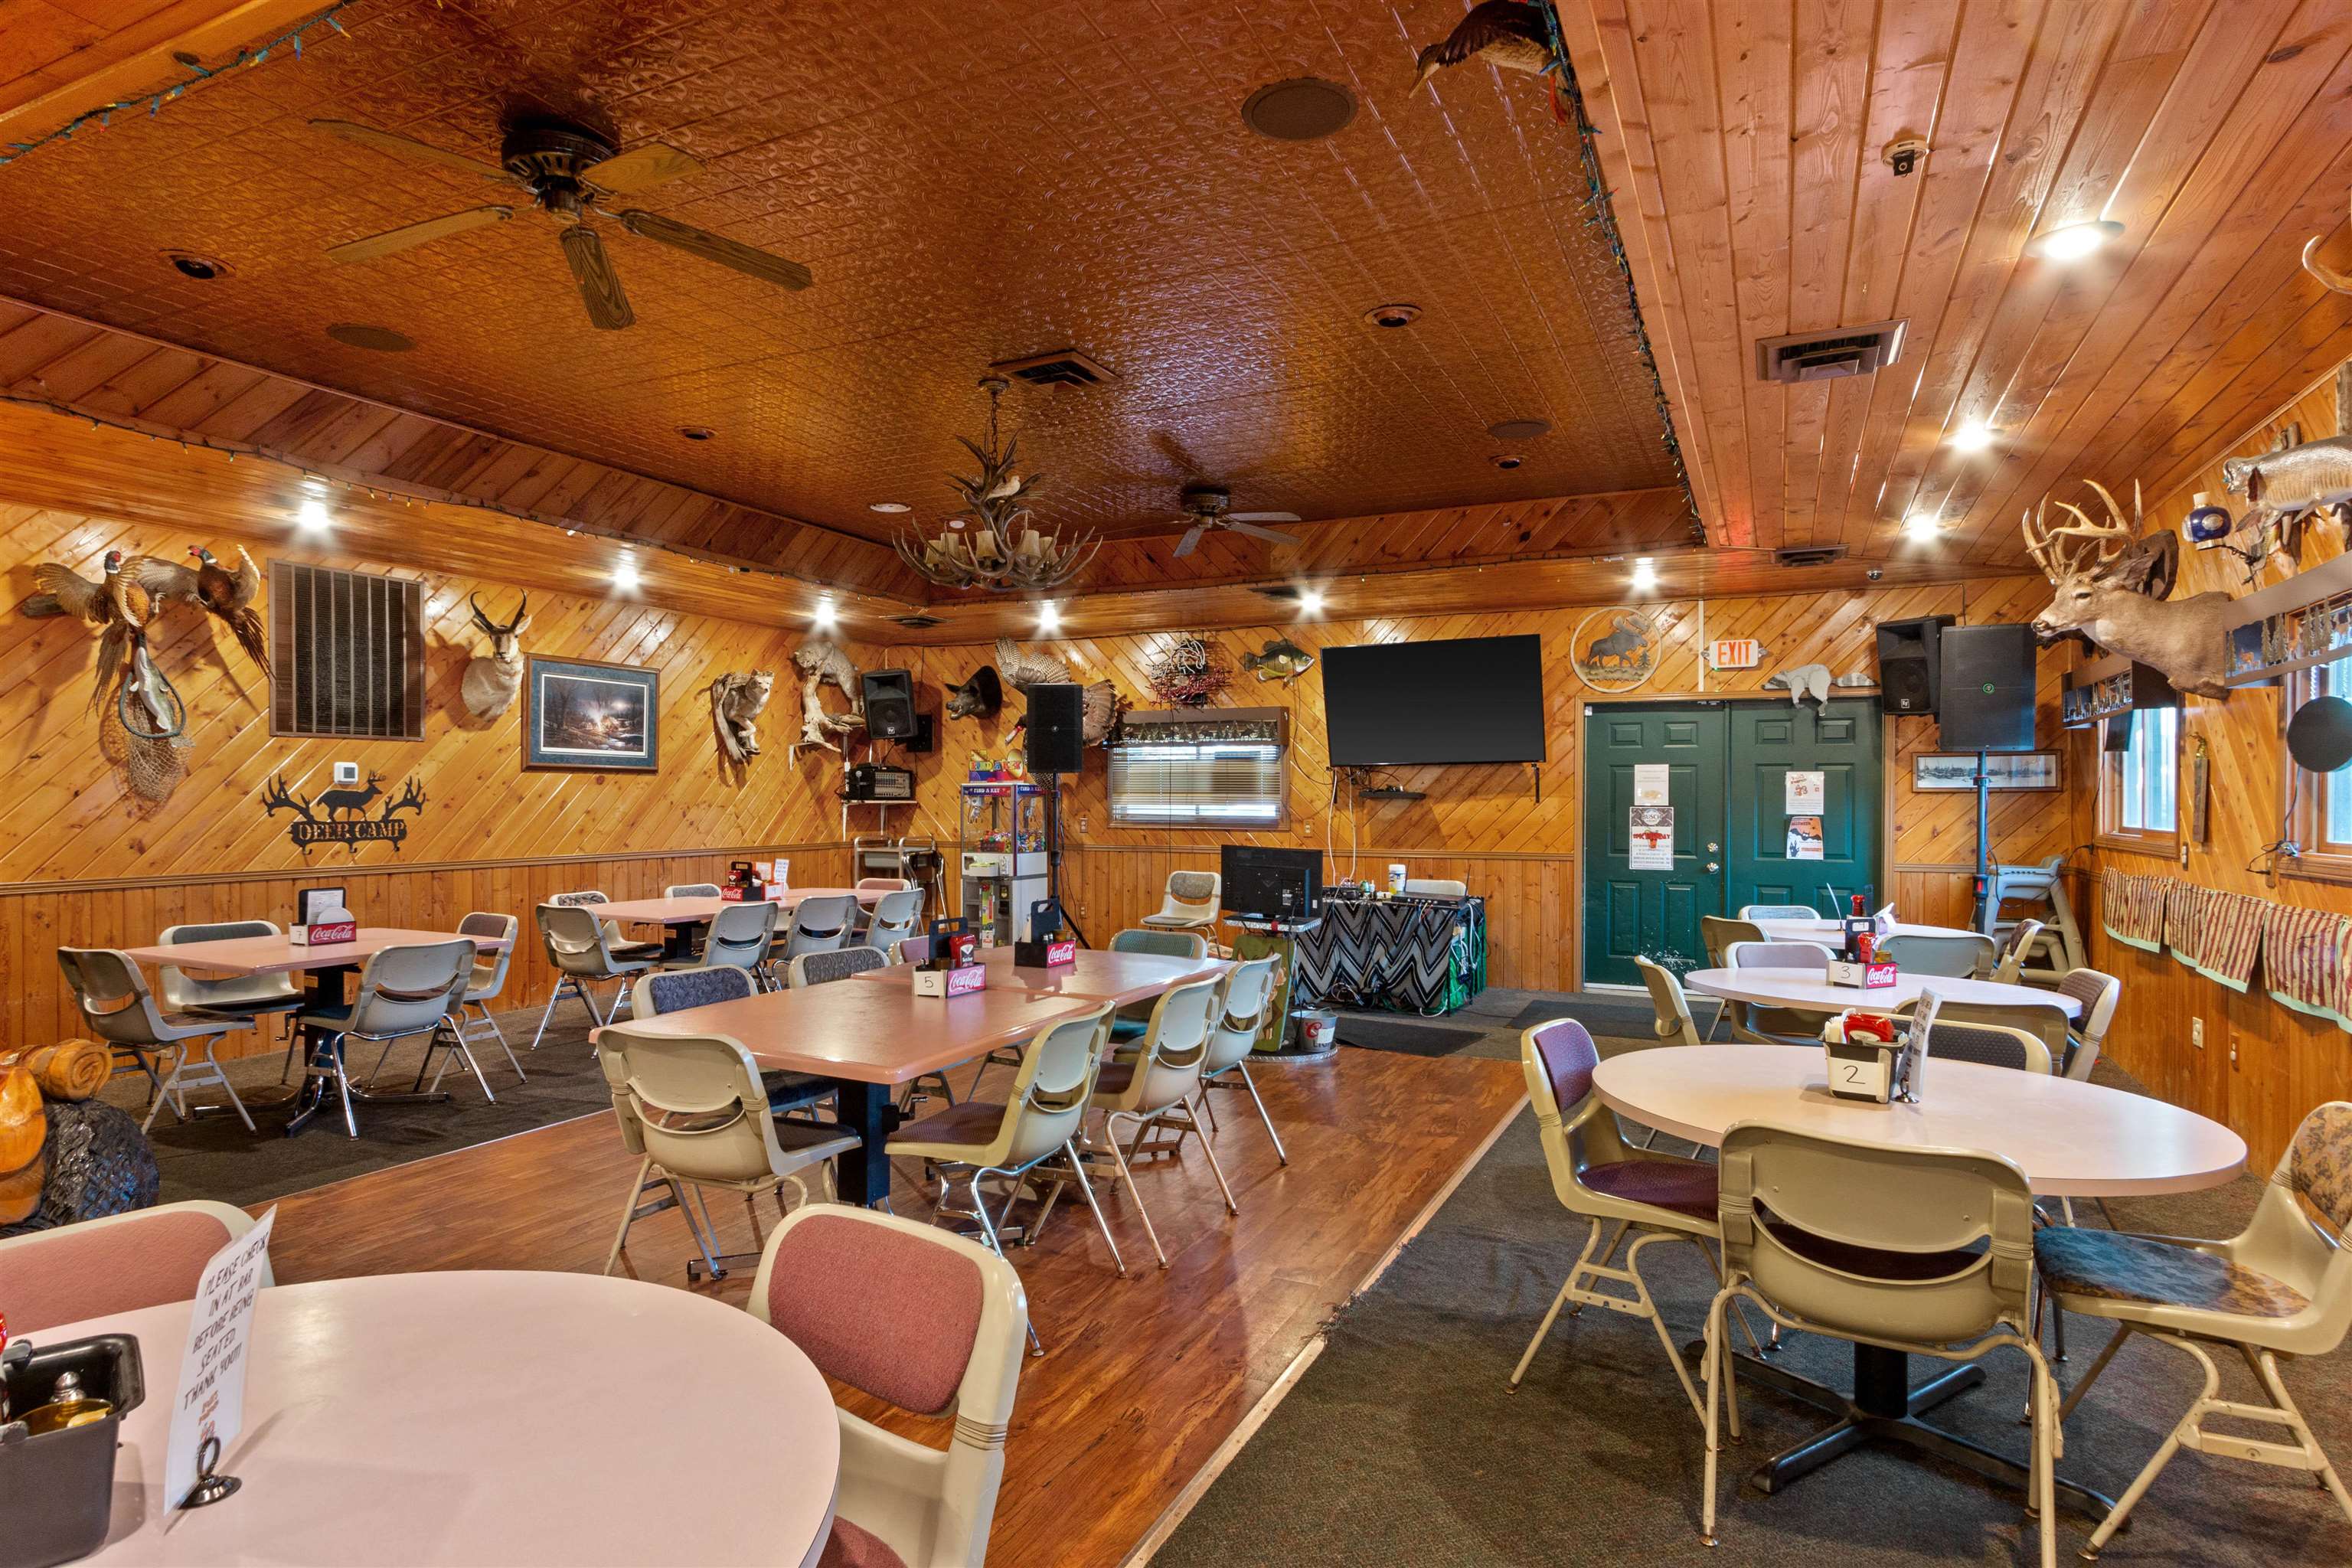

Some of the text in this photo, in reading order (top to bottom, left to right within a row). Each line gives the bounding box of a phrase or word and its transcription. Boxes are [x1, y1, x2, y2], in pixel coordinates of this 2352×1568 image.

[1717, 641, 1752, 666] EXIT
[299, 819, 404, 840] DEER CAMP
[1642, 814, 1661, 822] BUSCH
[924, 975, 934, 988] 5
[1841, 965, 1851, 978] 3
[1843, 1065, 1866, 1084] 2
[204, 1231, 269, 1297] PLEASE CHECK
[208, 1268, 253, 1317] IN AT BAR
[193, 1288, 254, 1354] BEFORE BEING
[197, 1328, 236, 1377] SEATED
[184, 1366, 217, 1410] THANK
